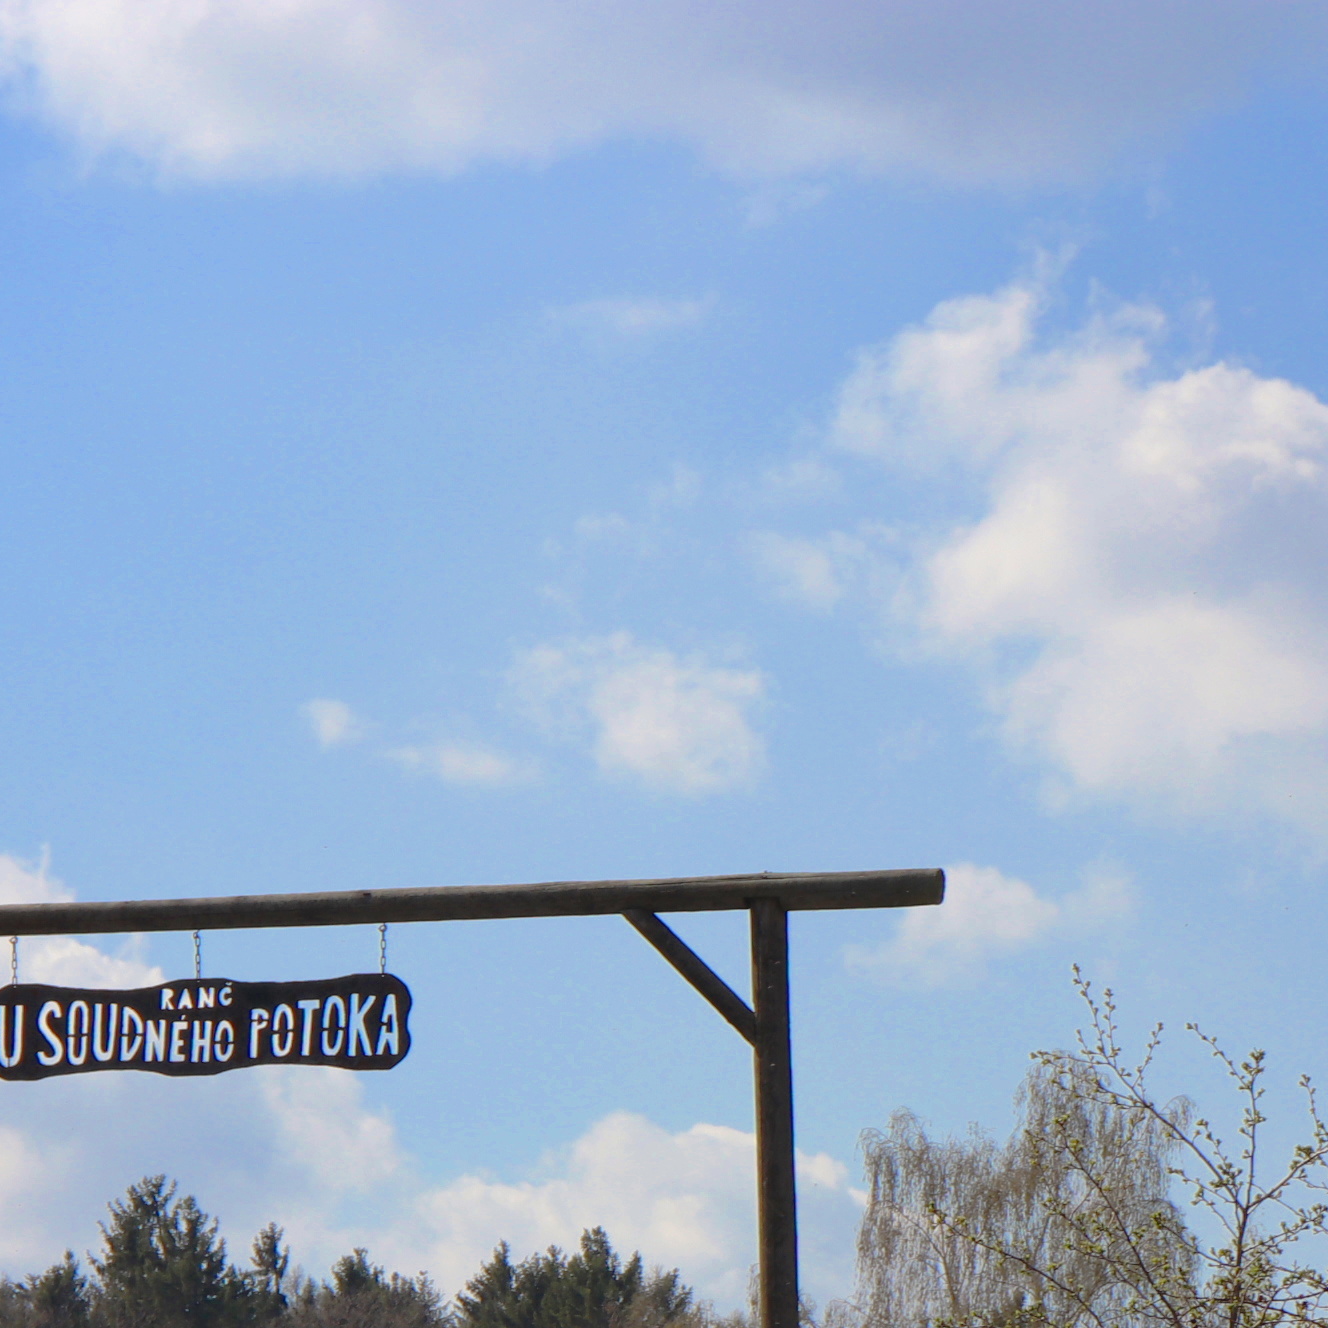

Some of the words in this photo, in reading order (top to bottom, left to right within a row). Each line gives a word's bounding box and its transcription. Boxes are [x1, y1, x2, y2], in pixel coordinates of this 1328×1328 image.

[160, 982, 233, 1010] RANČ
[36, 1000, 234, 1067] SOUDNÉHO
[249, 993, 400, 1059] POTOKA
